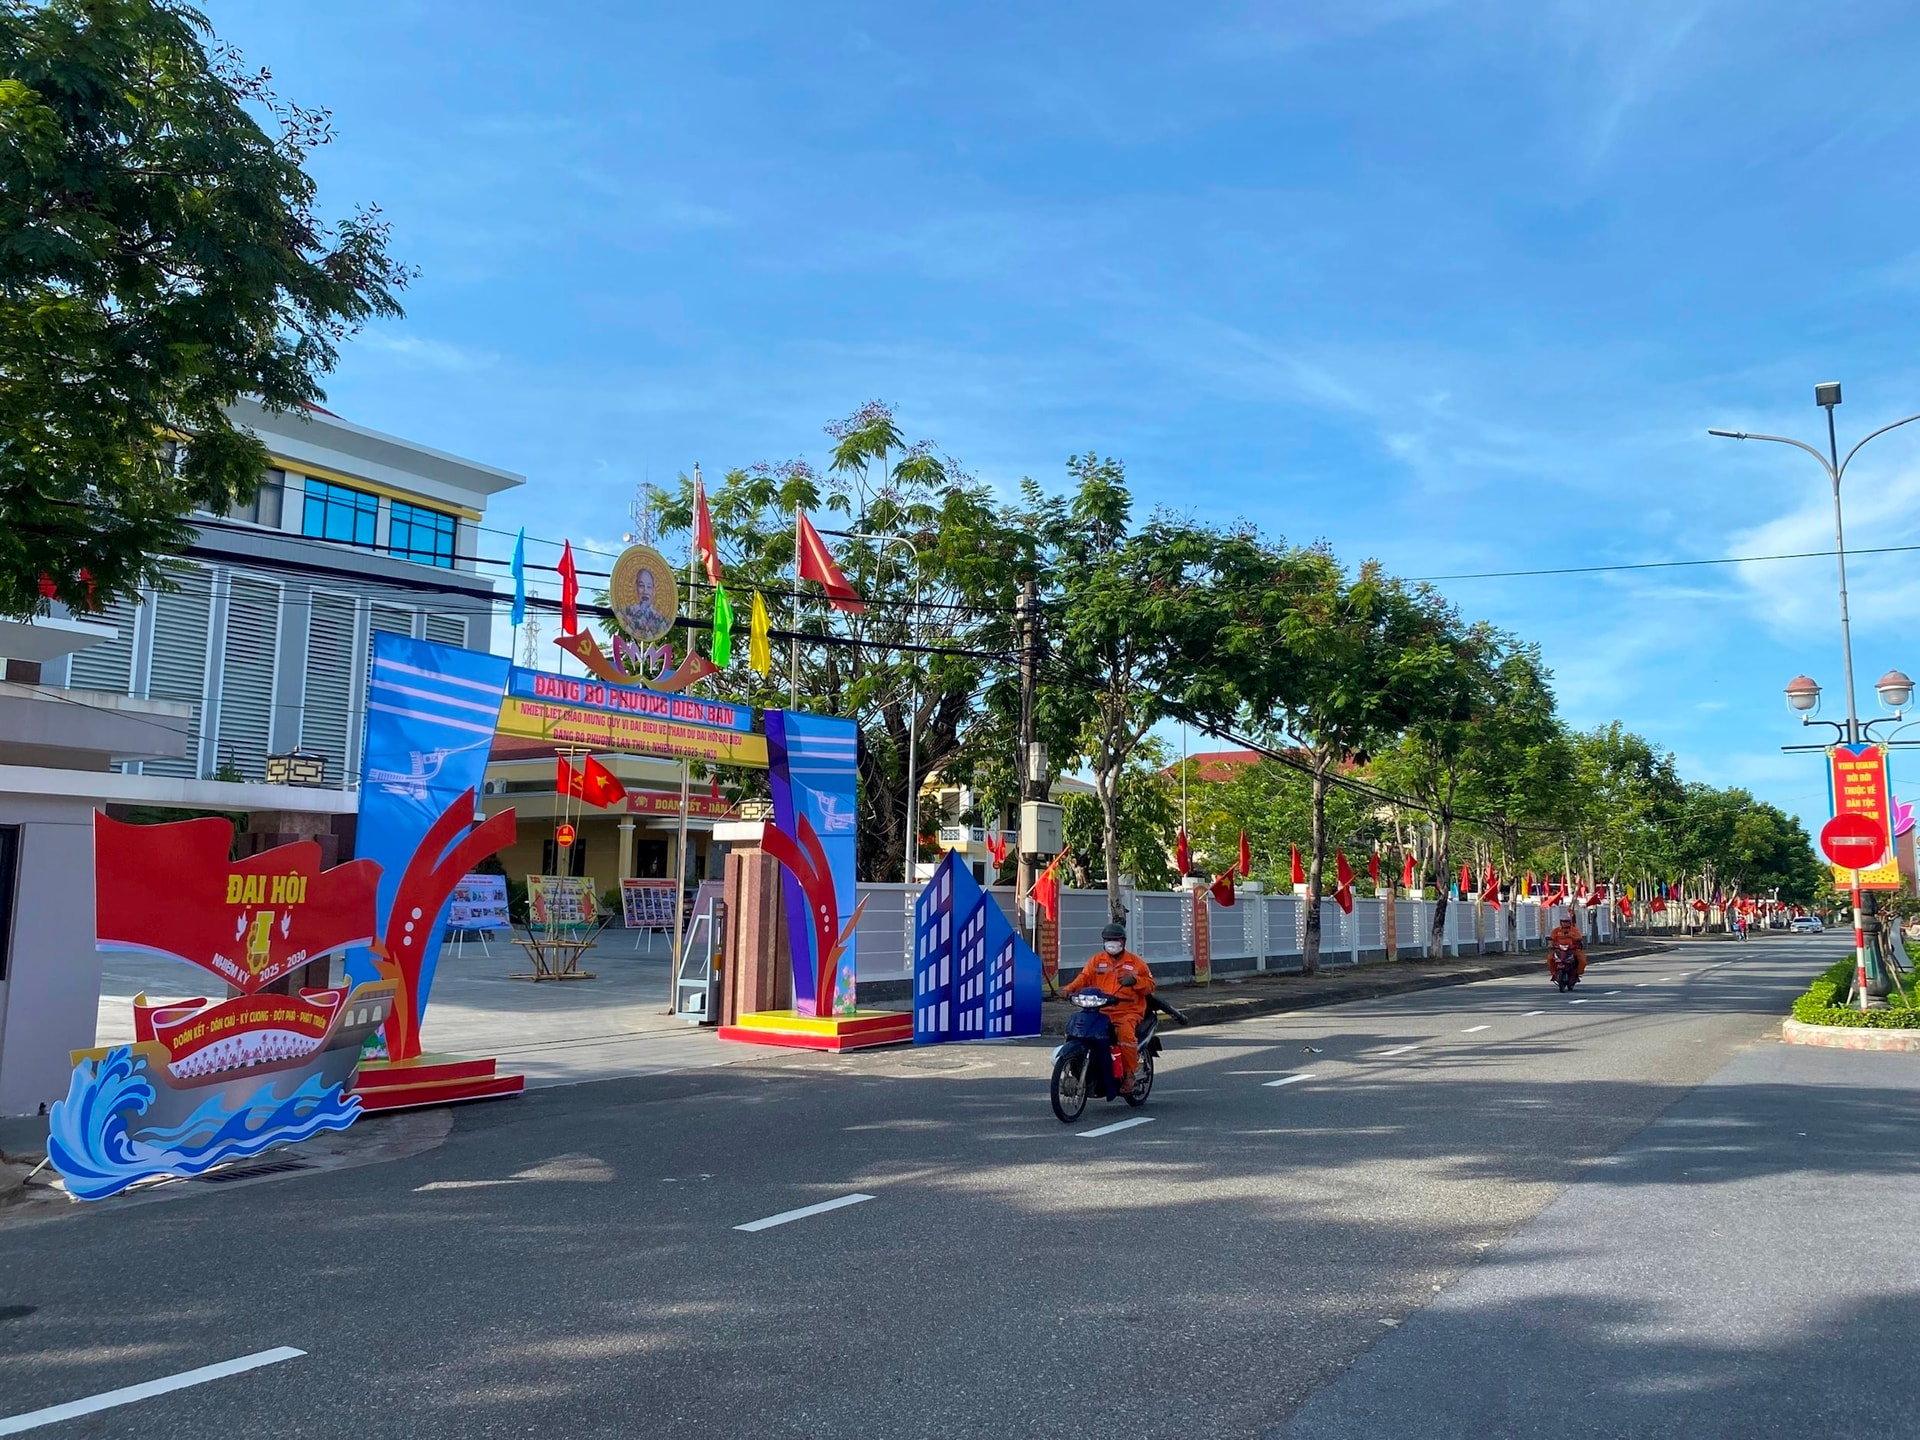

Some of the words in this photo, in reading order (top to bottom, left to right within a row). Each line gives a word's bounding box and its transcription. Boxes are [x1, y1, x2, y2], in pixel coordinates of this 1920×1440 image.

[225, 874, 266, 909] ĐẠI
[271, 870, 308, 909] HỘI
[211, 952, 239, 978] NHIỆM
[259, 962, 280, 983] 2025
[286, 949, 307, 968] 2030
